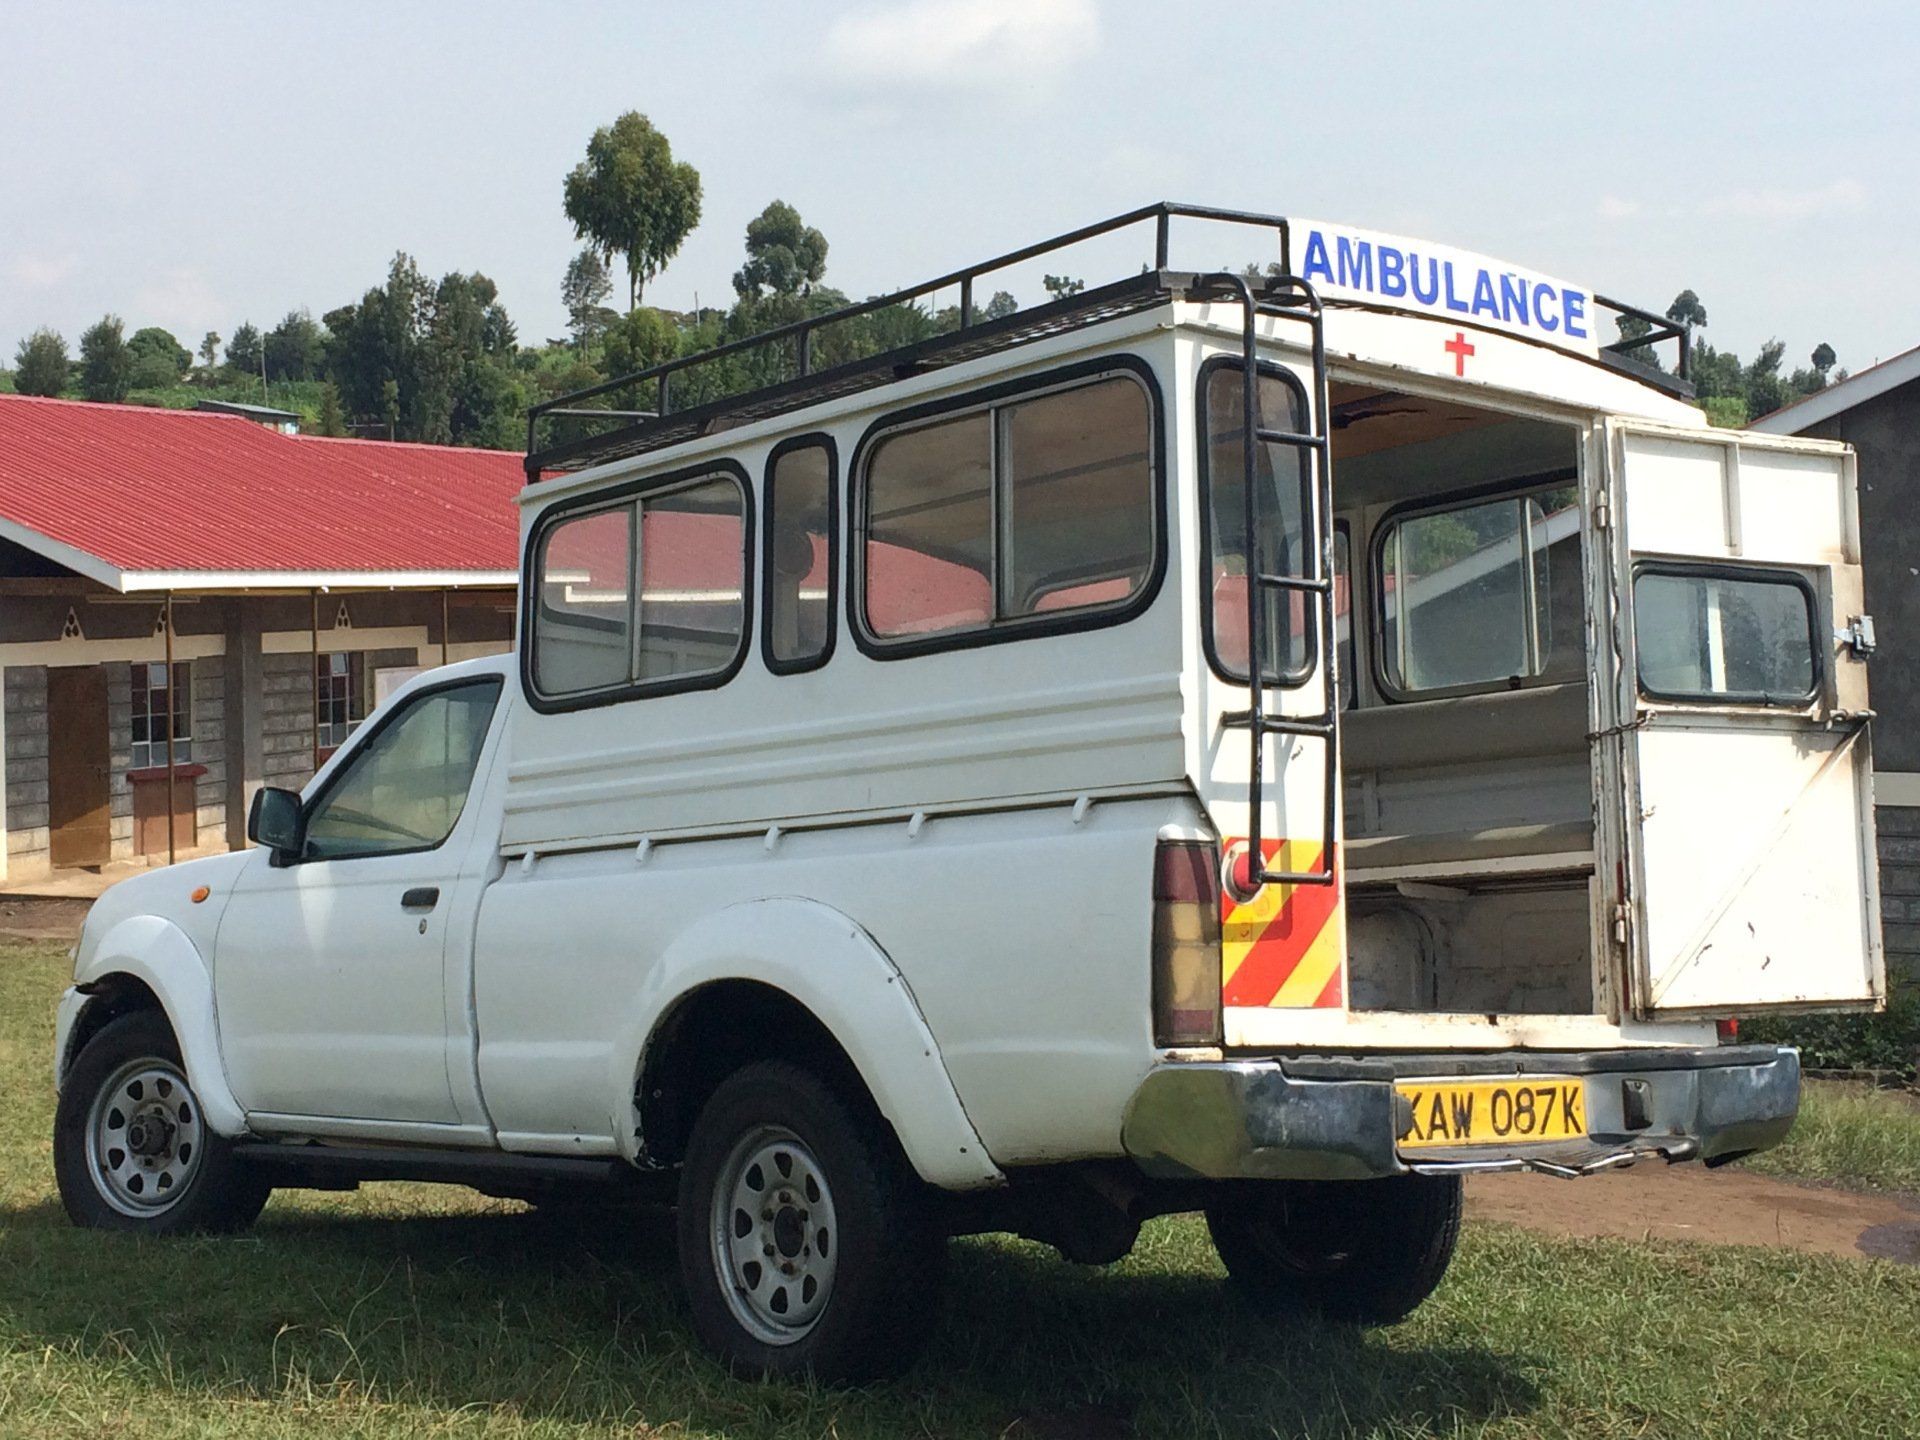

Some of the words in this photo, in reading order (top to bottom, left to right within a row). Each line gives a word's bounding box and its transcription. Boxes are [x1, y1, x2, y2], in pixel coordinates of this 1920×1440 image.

[1303, 230, 1587, 339] AMBULANCE
[1402, 1091, 1474, 1141] KAW
[1490, 1086, 1582, 1137] 087K
